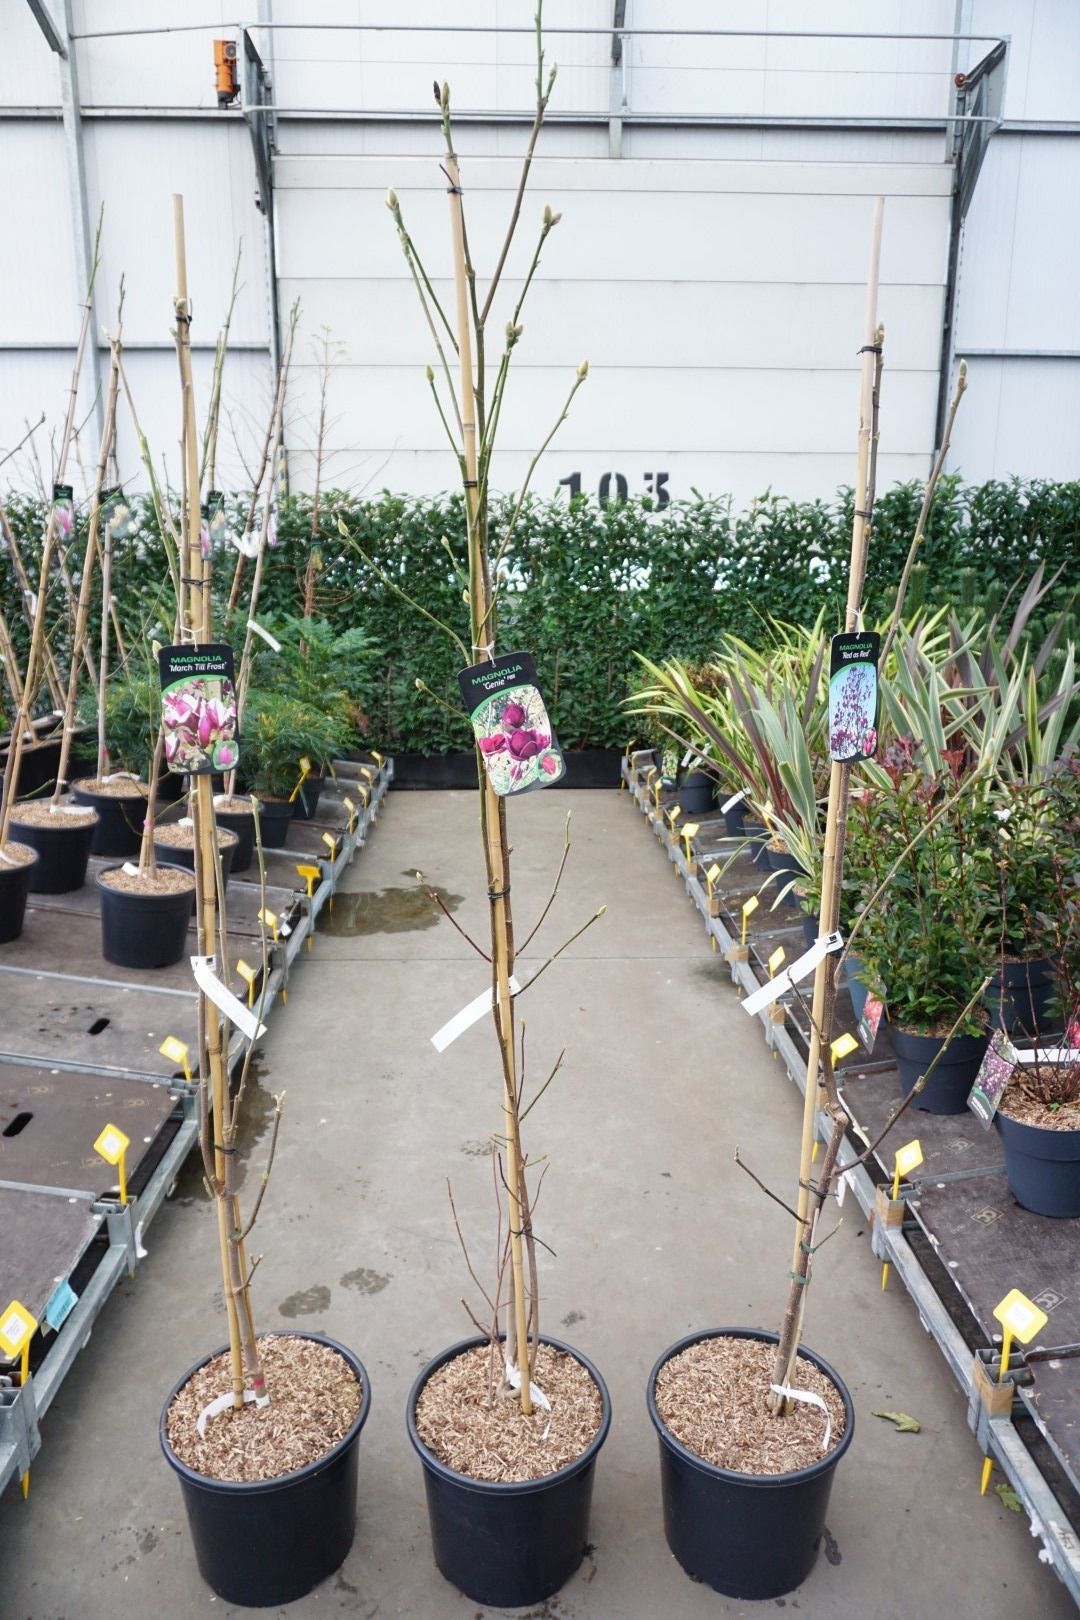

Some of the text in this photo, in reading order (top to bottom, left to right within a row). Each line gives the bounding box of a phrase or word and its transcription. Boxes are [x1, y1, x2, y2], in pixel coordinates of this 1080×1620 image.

[559, 471, 670, 513] 103
[839, 642, 873, 651] MAGNOLIA
[170, 655, 222, 664] MAGNOLIA
[194, 663, 206, 671] Till
[471, 664, 523, 686] MAGNOLIA
